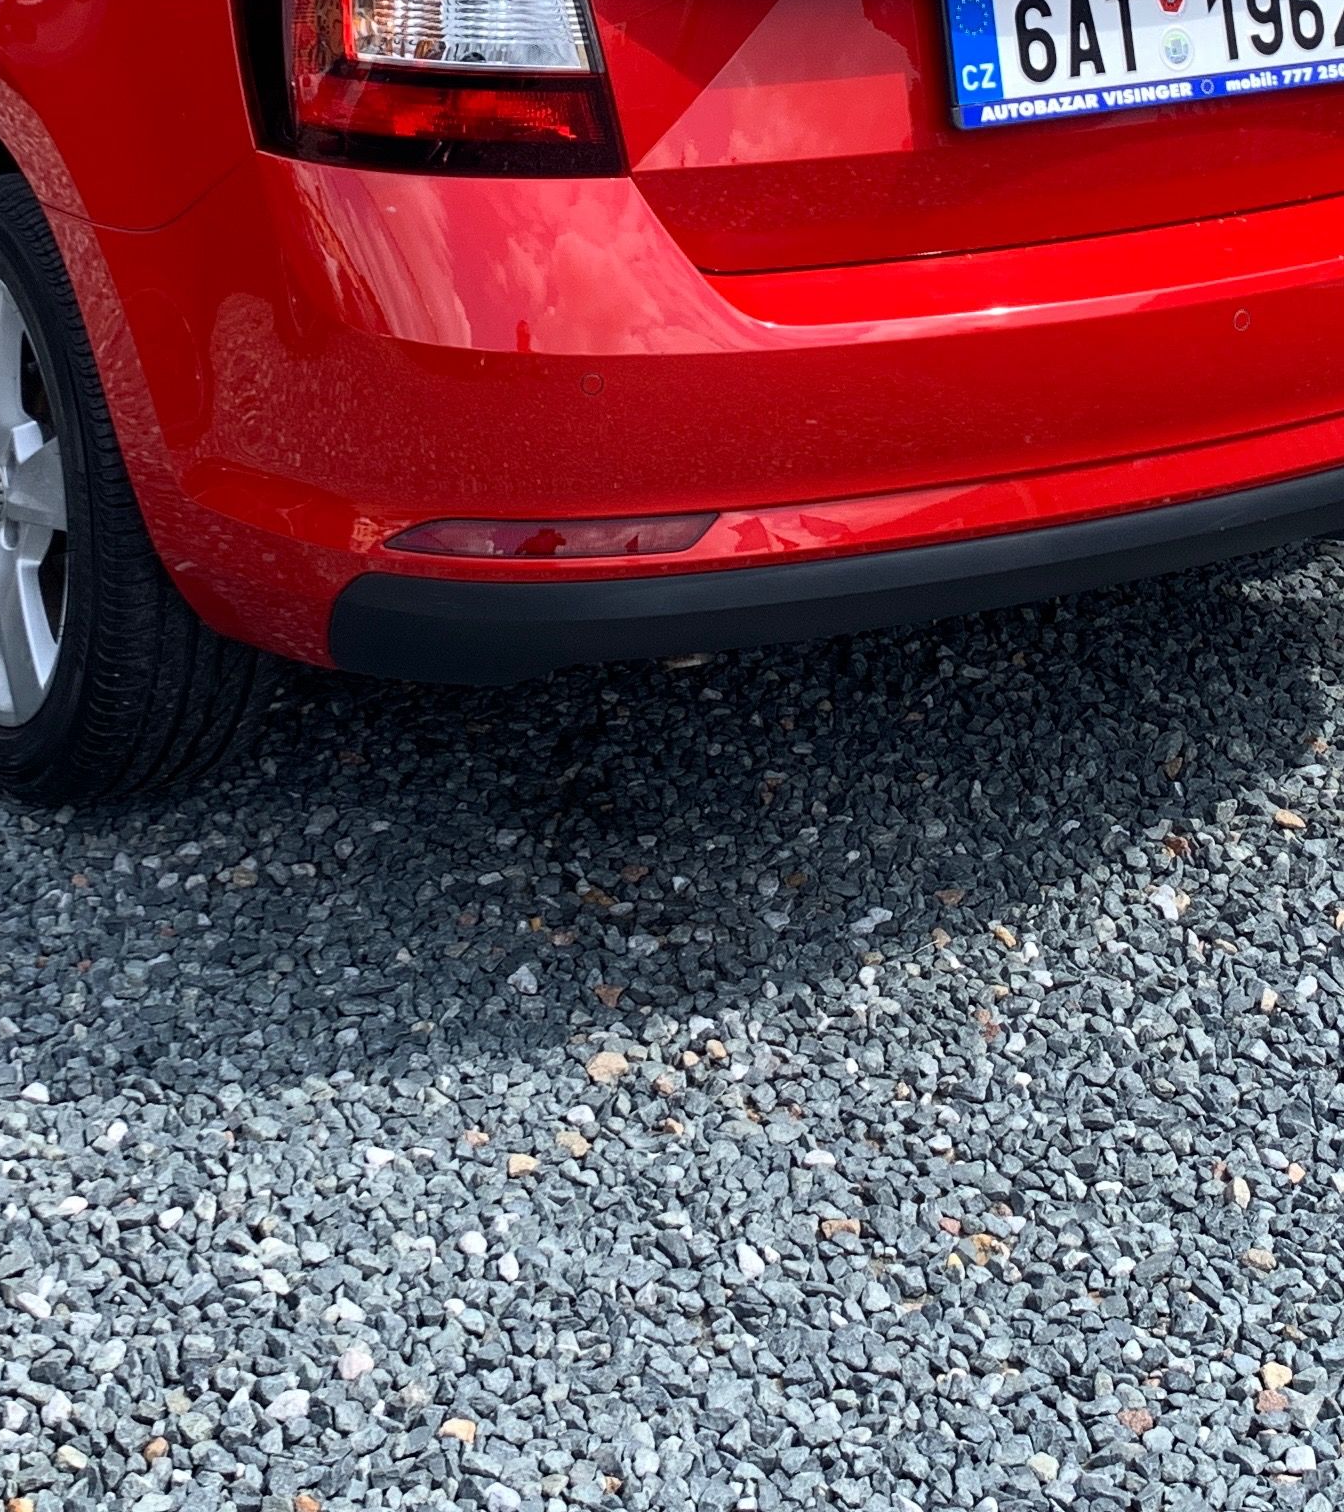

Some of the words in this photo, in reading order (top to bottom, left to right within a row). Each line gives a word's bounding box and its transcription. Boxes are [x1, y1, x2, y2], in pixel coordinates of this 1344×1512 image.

[962, 64, 997, 92] CZ
[980, 93, 1099, 123] AUTOBAZAR
[1103, 82, 1193, 107] VISINGER
[1225, 72, 1279, 92] mobil:
[1281, 66, 1314, 86] 777
